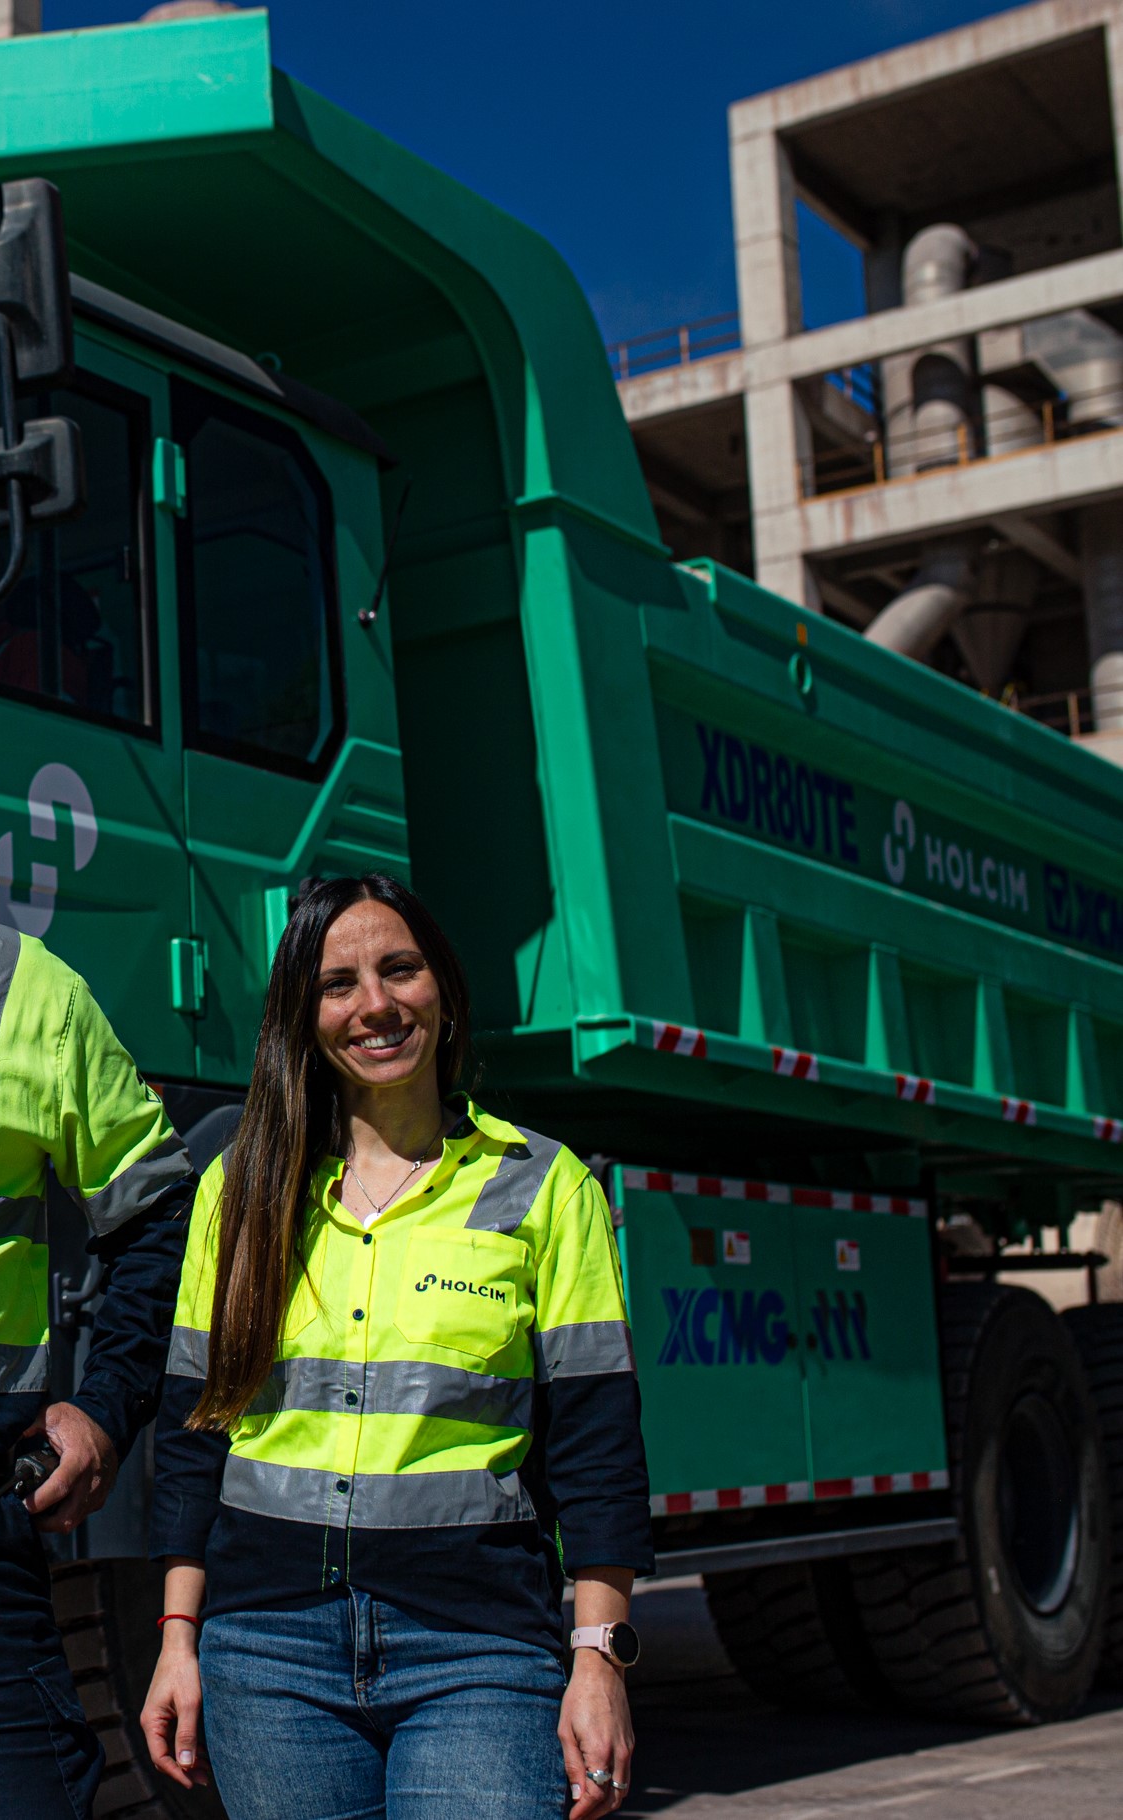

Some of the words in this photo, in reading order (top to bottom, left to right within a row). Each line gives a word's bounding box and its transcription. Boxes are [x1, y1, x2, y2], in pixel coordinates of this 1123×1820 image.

[697, 723, 859, 862] XDR80TE
[924, 833, 1029, 912] HOLCIM
[440, 1279, 506, 1303] HOLCIM
[657, 1288, 789, 1366] XCMG
